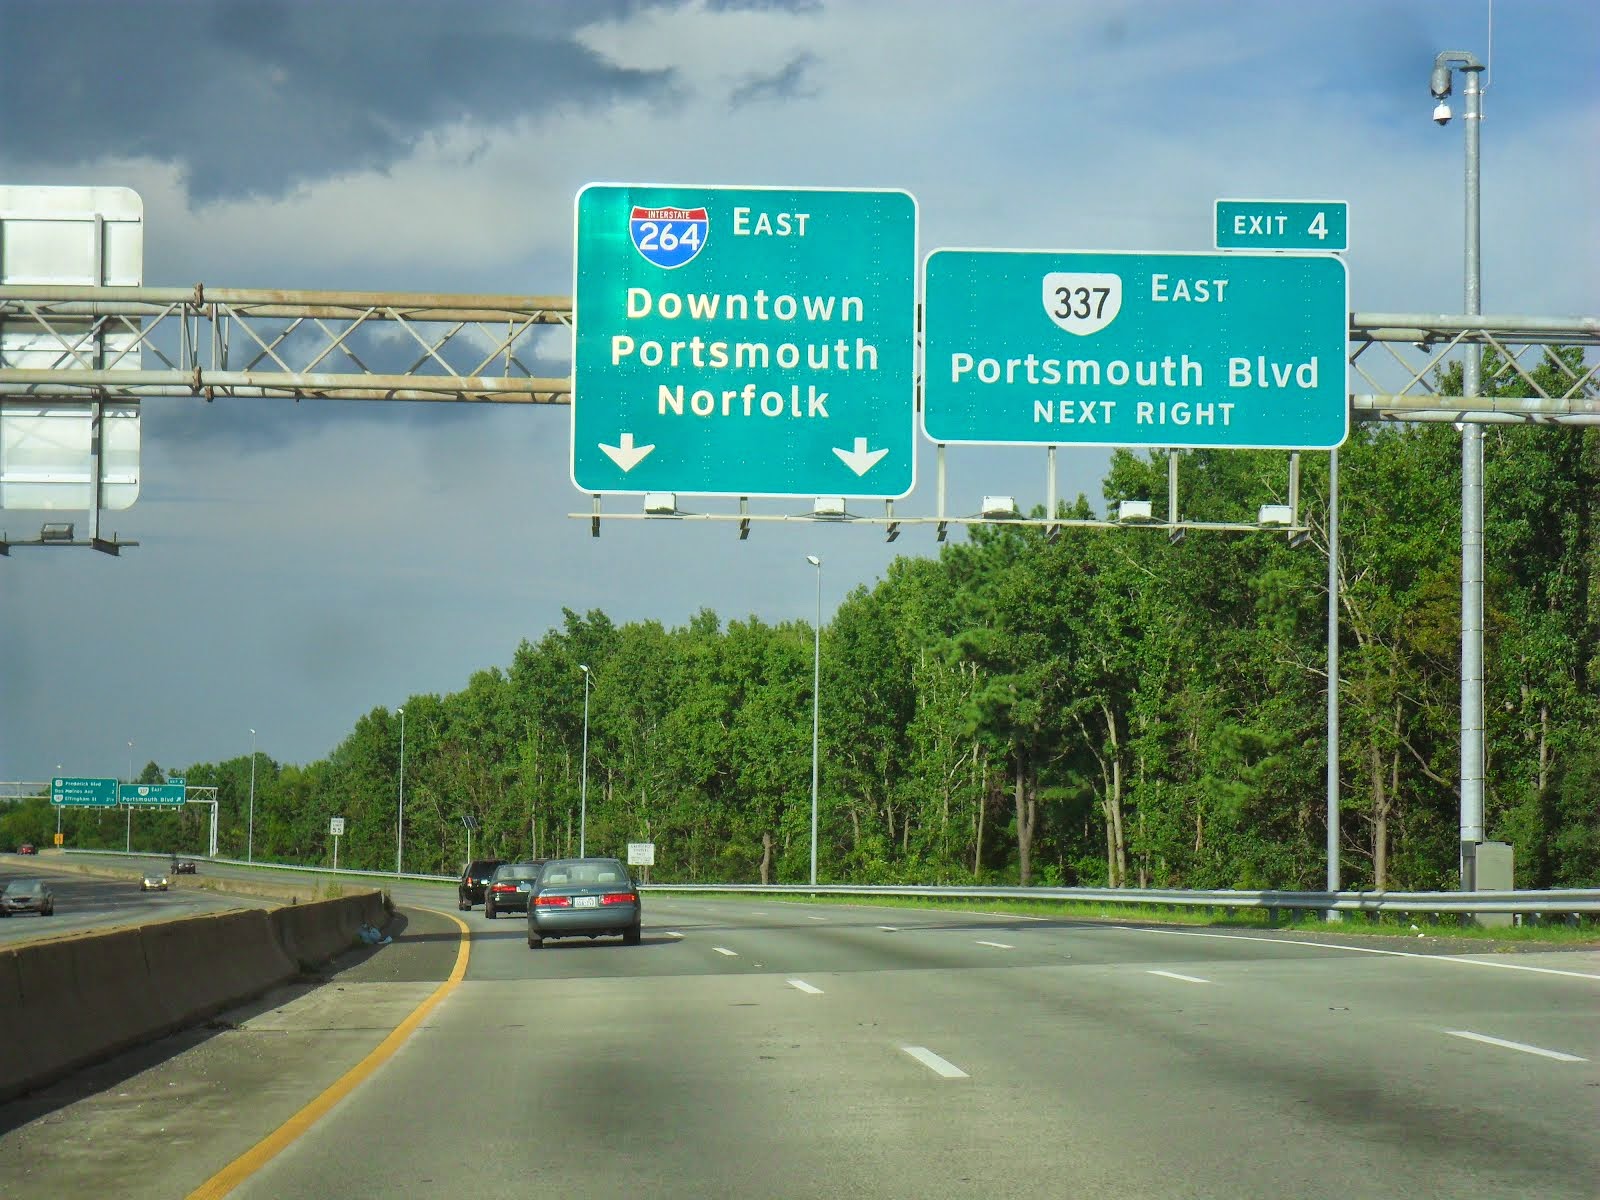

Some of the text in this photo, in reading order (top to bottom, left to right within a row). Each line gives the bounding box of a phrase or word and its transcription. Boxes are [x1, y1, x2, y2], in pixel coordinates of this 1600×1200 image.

[647, 210, 690, 220] INTERSTATE
[733, 207, 810, 237] EAST
[1233, 212, 1329, 240] EXIT 4
[639, 222, 700, 251] 264
[1053, 286, 1111, 320] 337
[1151, 273, 1229, 303] EAST
[626, 287, 864, 322] Downtown
[611, 335, 878, 370] Portsmouth
[951, 352, 1319, 389] Portsmouth Blvd
[658, 383, 830, 418] Norfolk
[1033, 400, 1235, 426] NEXT RIGHT
